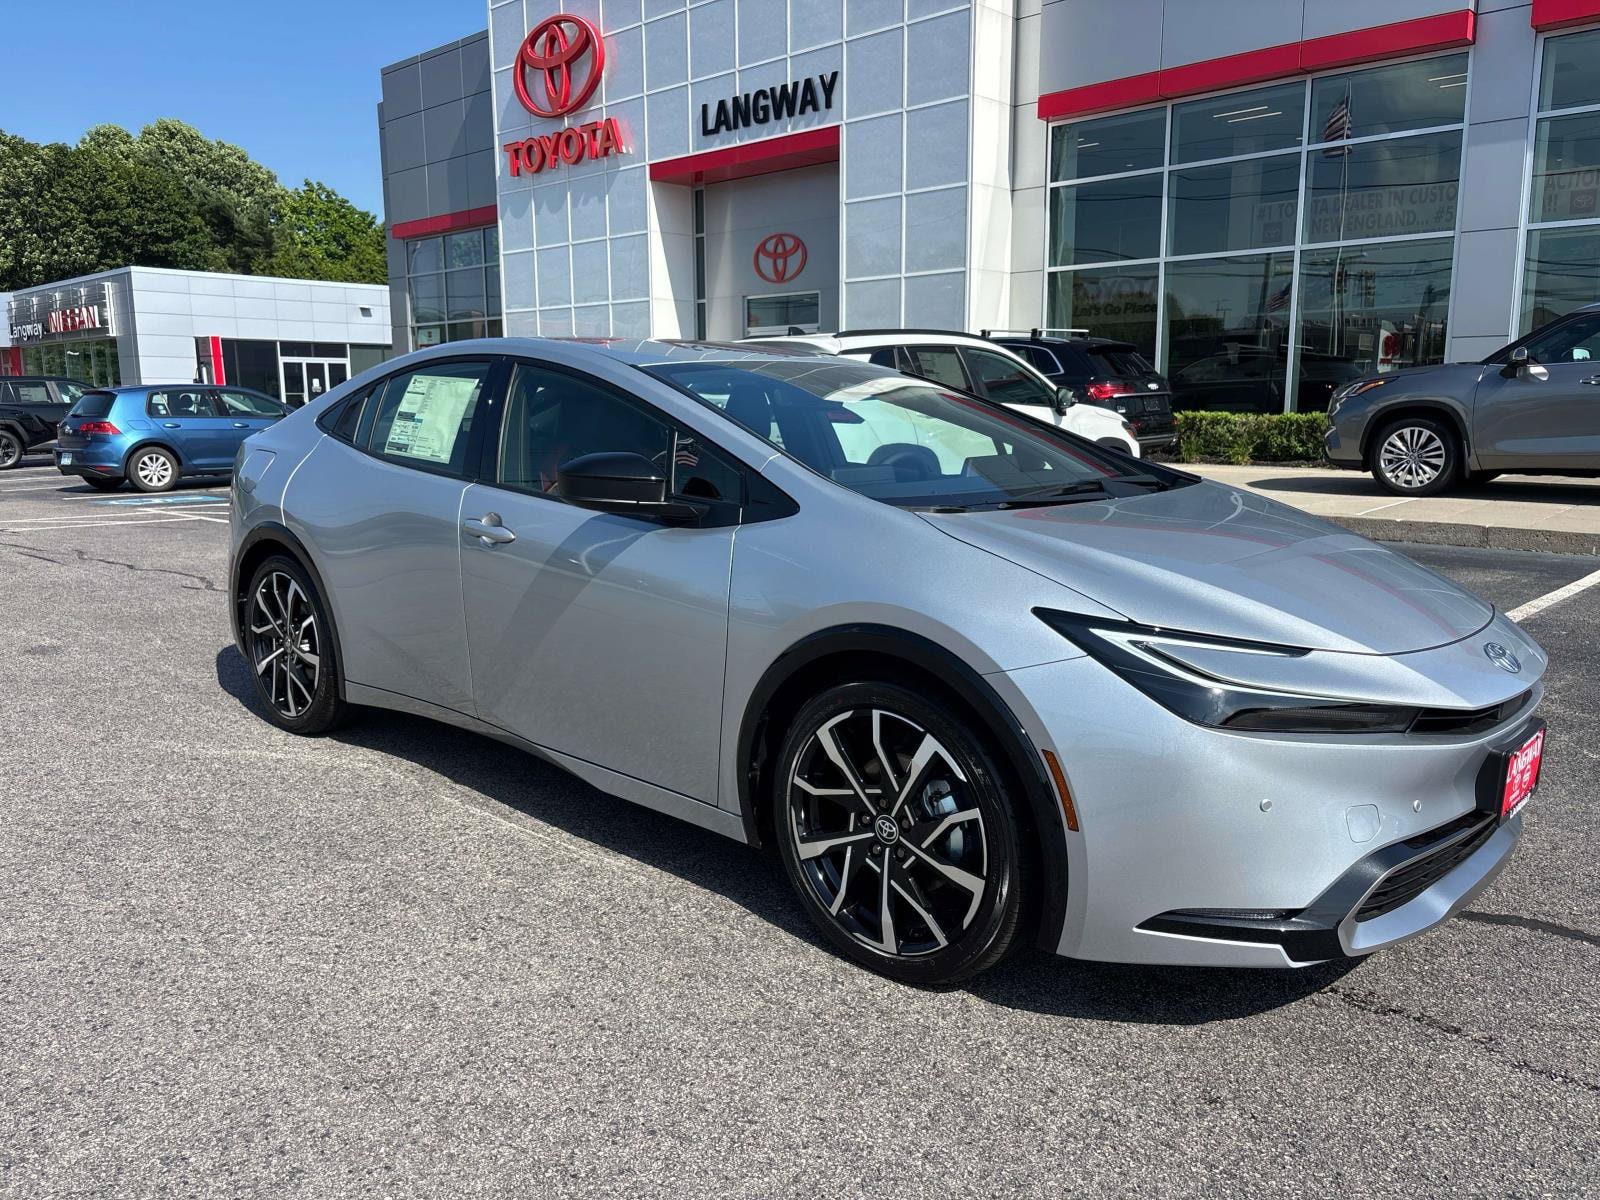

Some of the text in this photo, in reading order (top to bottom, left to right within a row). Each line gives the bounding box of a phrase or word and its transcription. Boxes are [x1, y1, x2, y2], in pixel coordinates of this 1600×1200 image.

[701, 71, 839, 136] LANGWAY
[503, 118, 623, 177] TOYOTA
[1278, 199, 1328, 220] TOTA
[1335, 191, 1383, 212] DEALER
[1388, 189, 1404, 206] IN
[1313, 217, 1339, 235] NEW
[48, 305, 99, 333] NISSAN
[1104, 303, 1121, 316] Go
